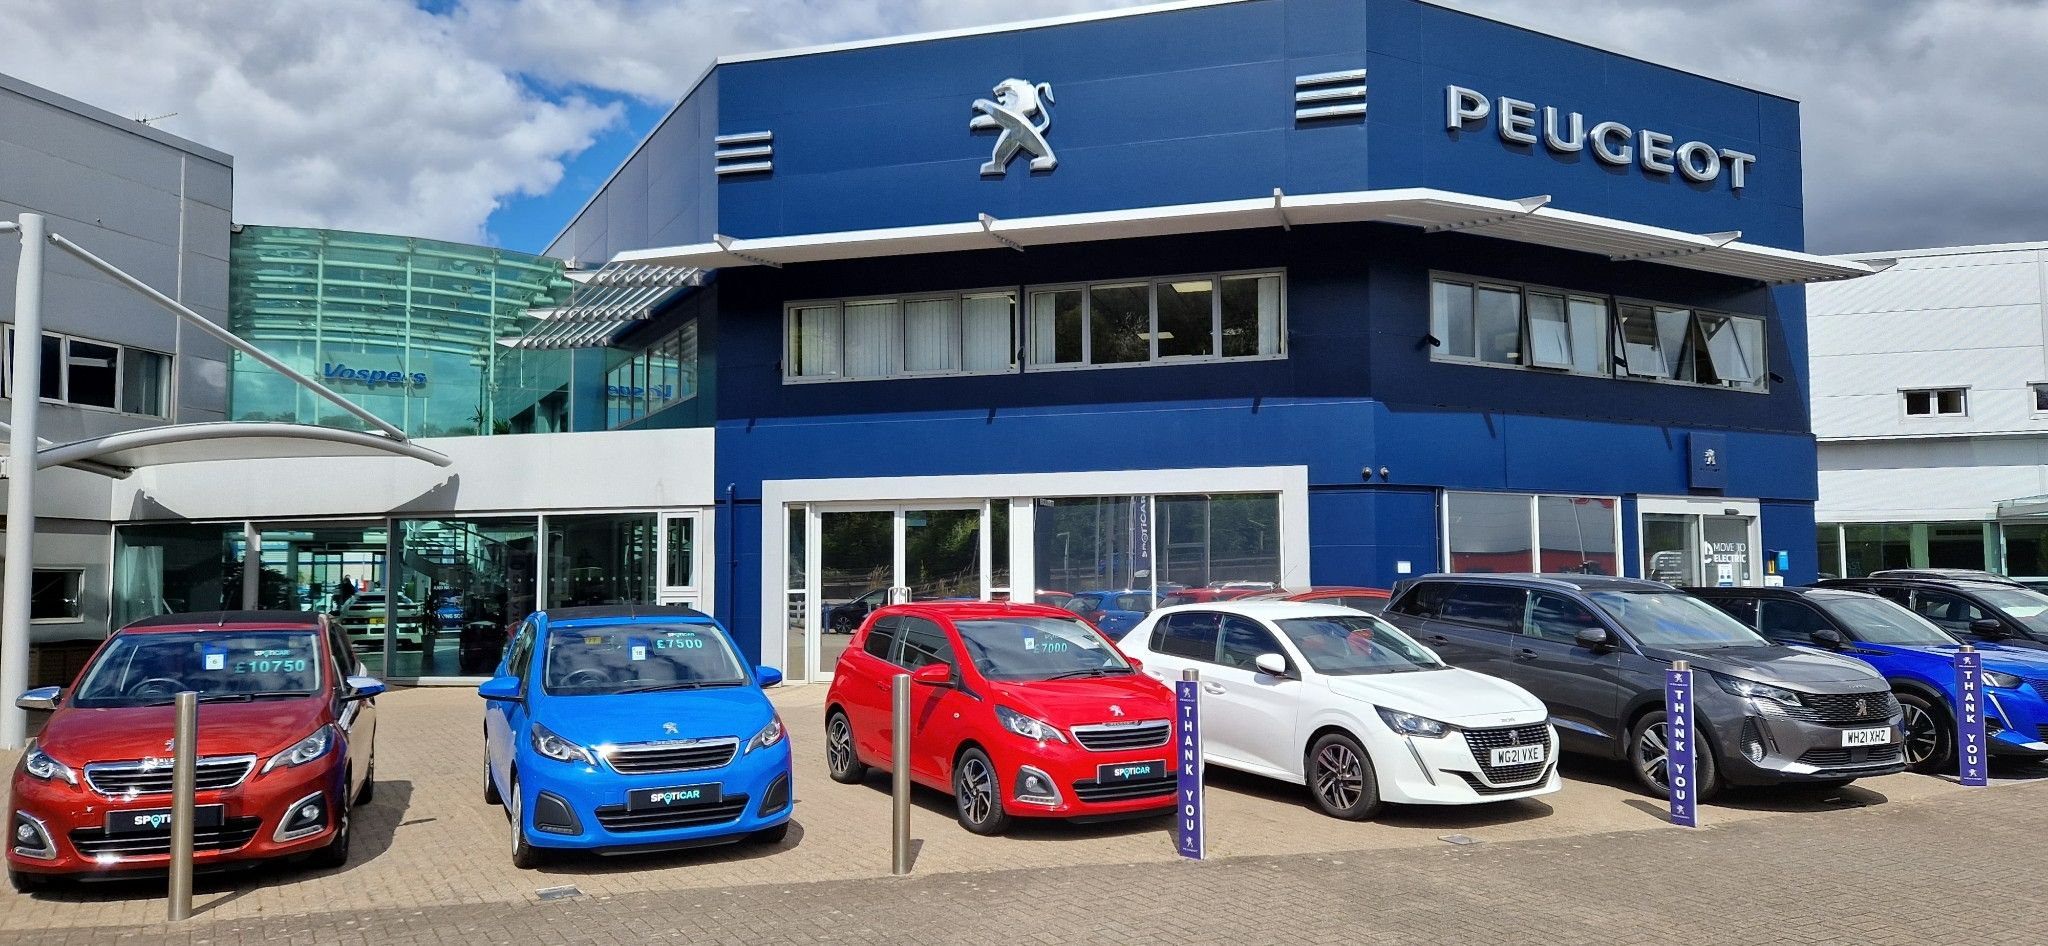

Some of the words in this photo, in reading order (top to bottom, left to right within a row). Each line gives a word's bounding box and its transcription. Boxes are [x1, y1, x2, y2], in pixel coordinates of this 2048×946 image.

[1446, 84, 1757, 189] PEUGEOT
[1713, 542, 1734, 552] MOVE
[1736, 542, 1746, 552] TO
[1714, 554, 1747, 563] ELECTRIC
[656, 639, 703, 649] £7500
[1033, 643, 1068, 653] £7000
[234, 660, 305, 673] £10750
[1964, 671, 1976, 723] THANK
[1674, 690, 1685, 751] THANK
[1184, 706, 1194, 775] THANK
[1847, 731, 1868, 743] WH21
[1869, 729, 1886, 742] XHZ
[1498, 749, 1520, 763] WG21
[1522, 747, 1539, 761] VXE
[1967, 733, 1978, 765] YOU
[1114, 766, 1151, 779] SPOTICAR
[1675, 763, 1686, 800] YOU
[650, 789, 700, 804] SPOTICAR
[1185, 789, 1195, 831] YOU
[134, 813, 171, 828] SPOTI
